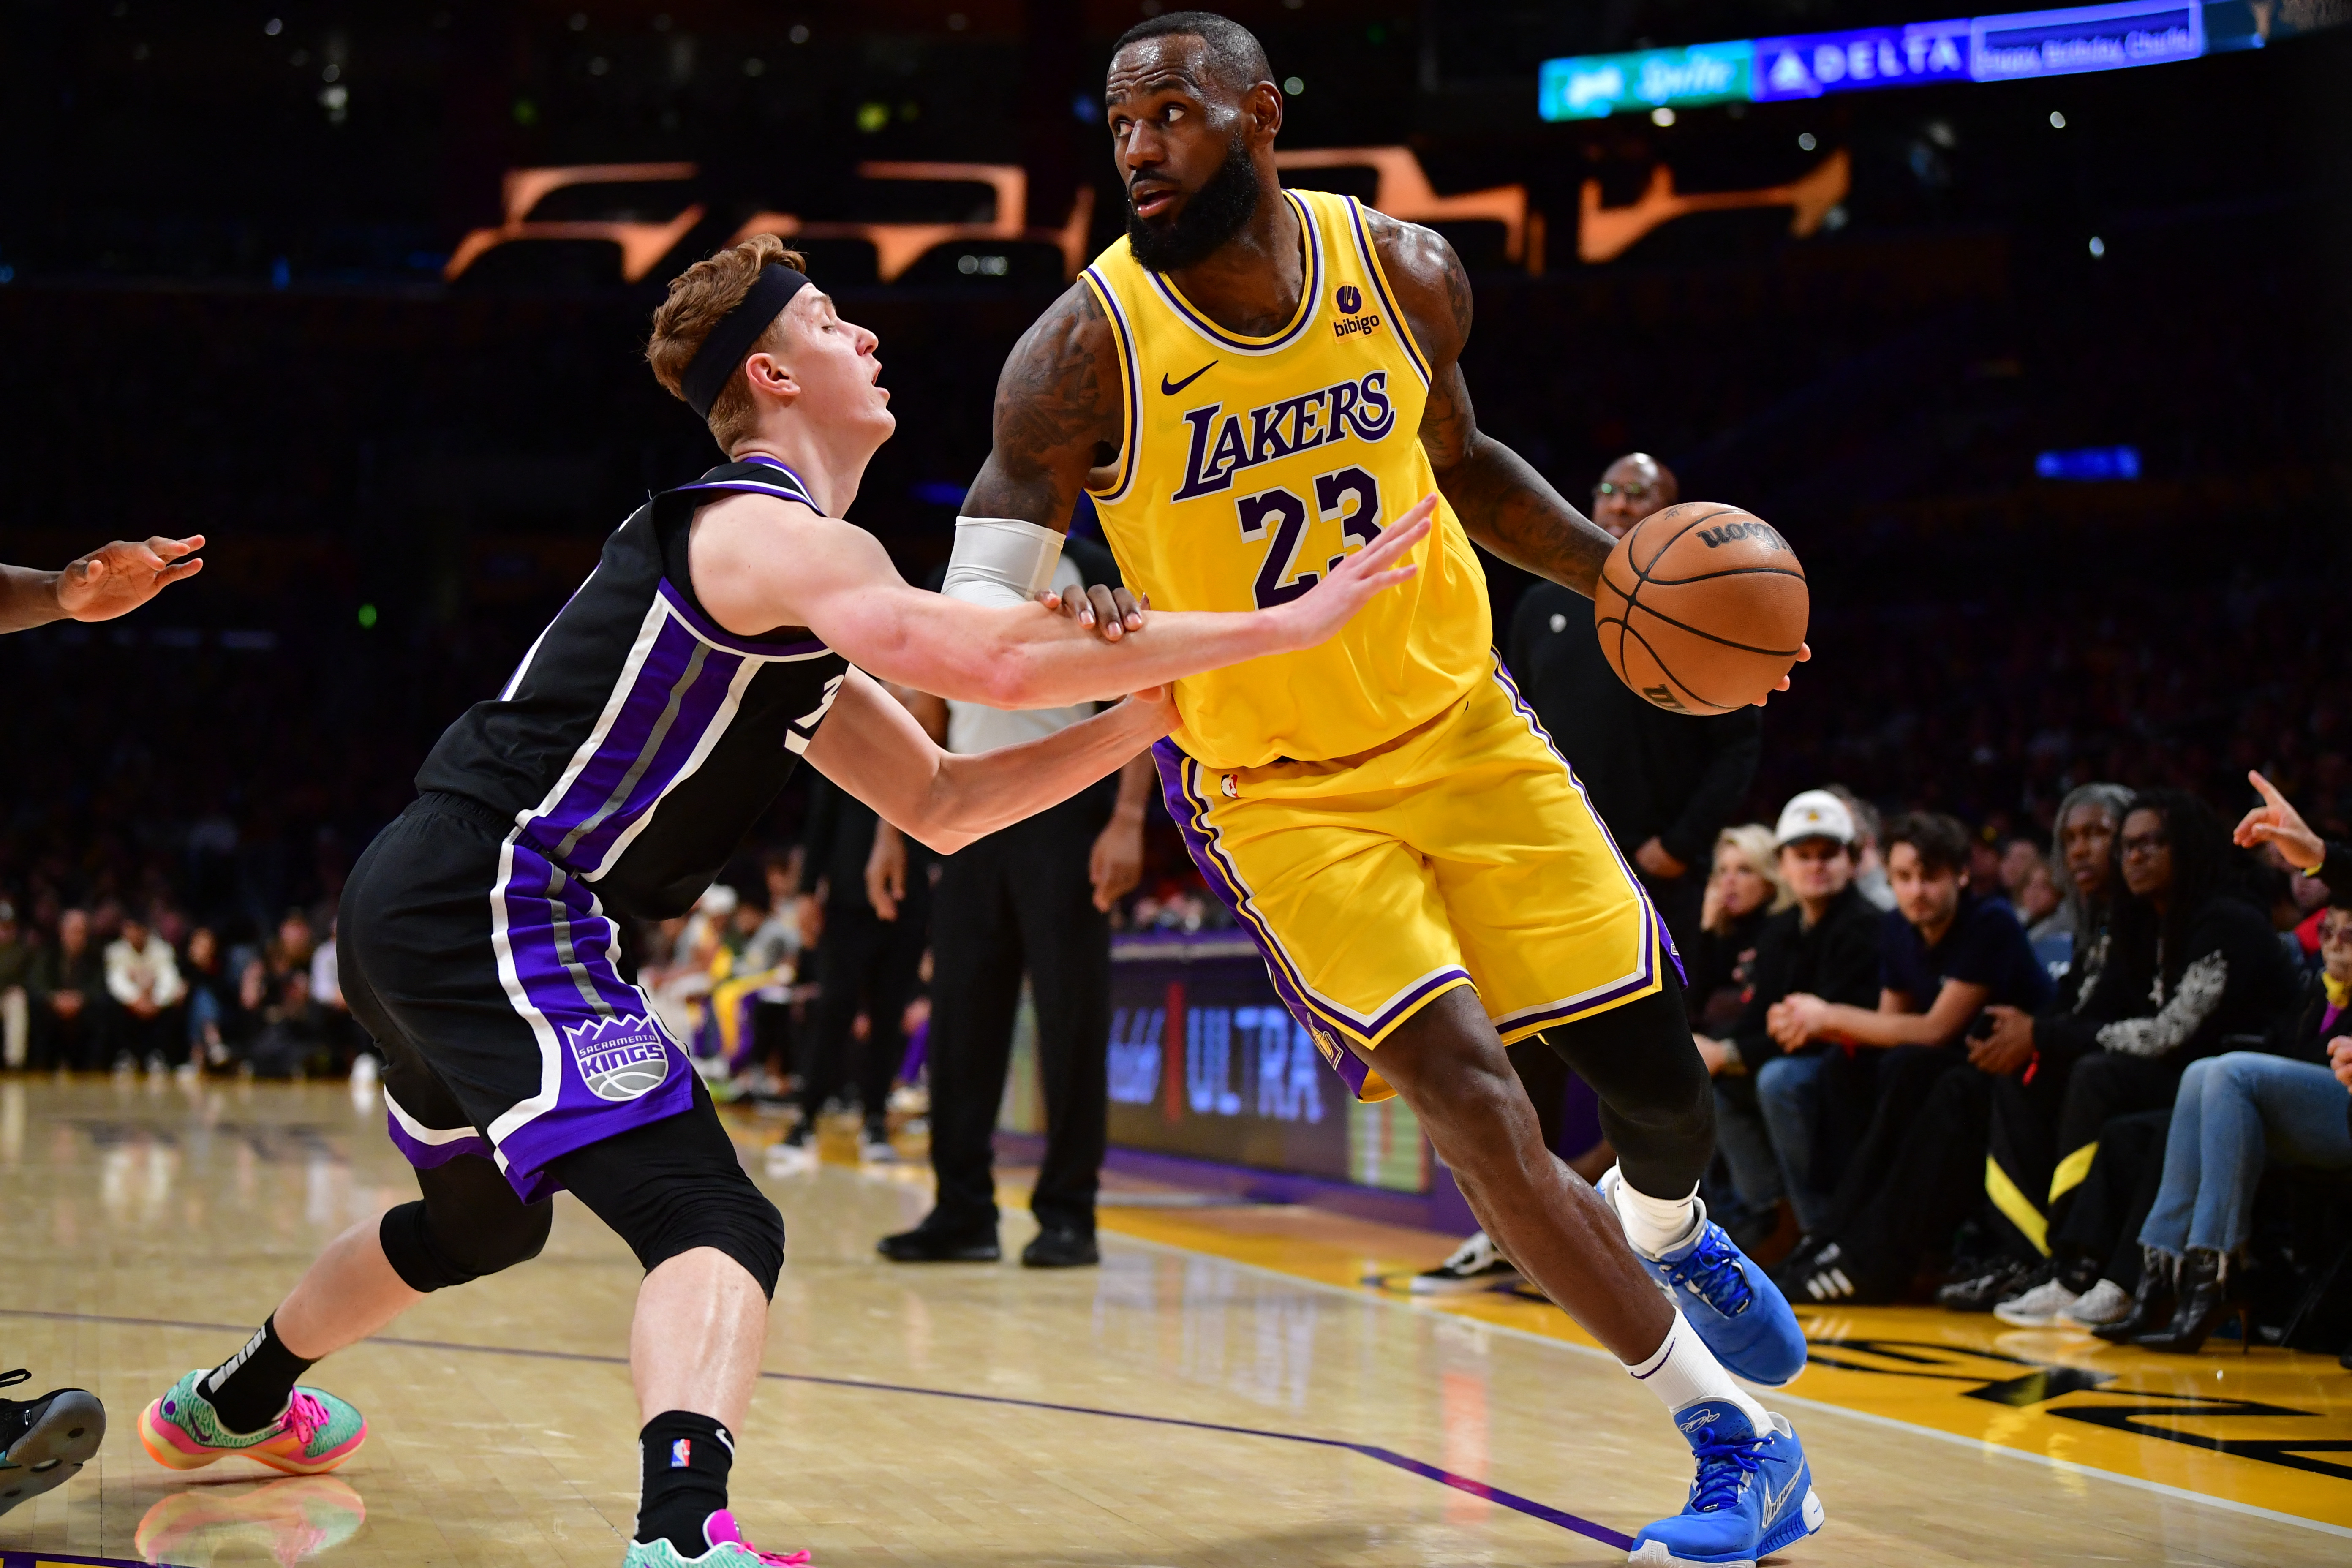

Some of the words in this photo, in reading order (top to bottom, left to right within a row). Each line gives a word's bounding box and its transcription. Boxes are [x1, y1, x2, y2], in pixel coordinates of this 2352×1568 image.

[1813, 35, 1961, 83] DELTA
[1333, 315, 1380, 337] bibigo
[1170, 370, 1396, 504] LAKERS
[1234, 464, 1384, 610] 23
[579, 1034, 656, 1057] SACRAMENTO
[580, 1044, 665, 1079] KINGS
[1186, 1004, 1324, 1124] ULTRA
